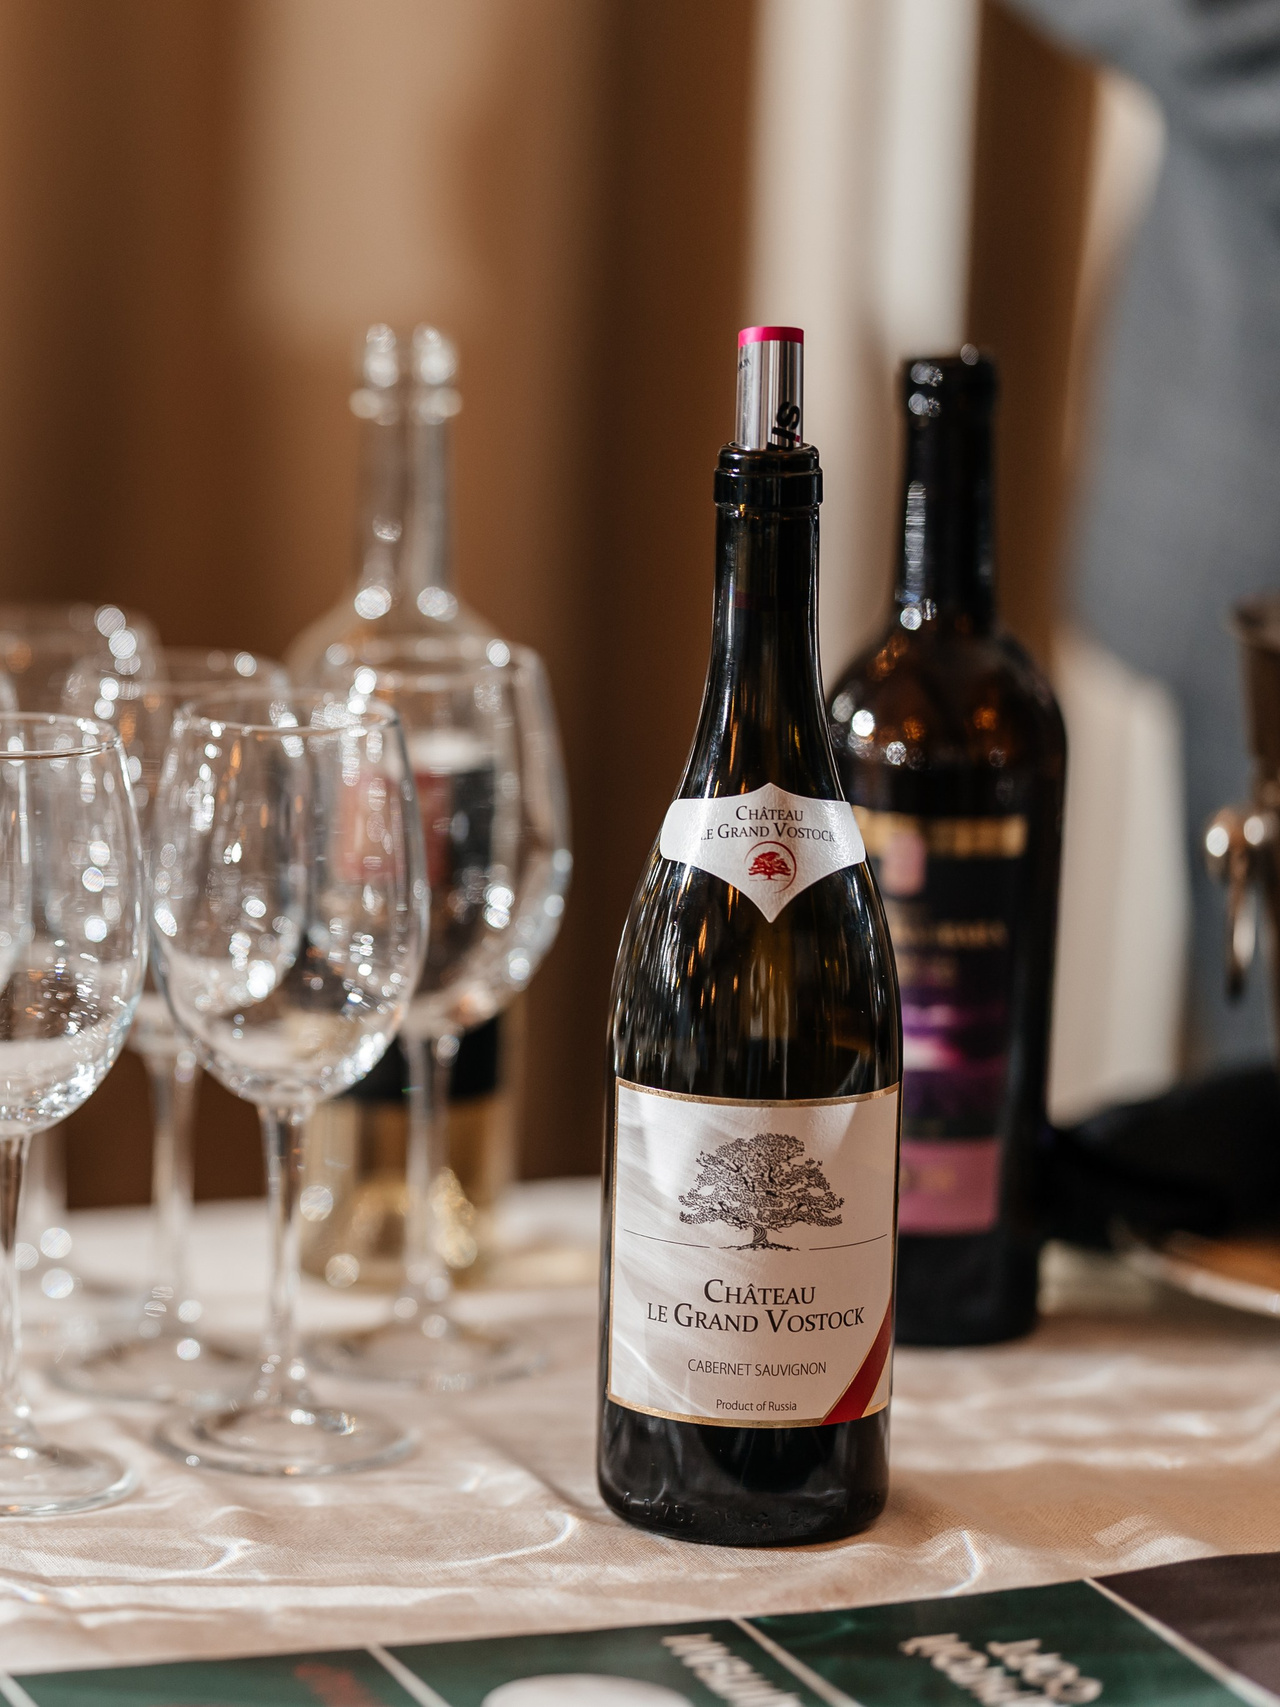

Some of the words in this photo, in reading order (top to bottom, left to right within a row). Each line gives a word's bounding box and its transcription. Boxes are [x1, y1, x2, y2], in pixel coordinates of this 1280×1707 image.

[736, 805, 804, 822] CHÂTEAU
[701, 828, 714, 840] E
[717, 823, 770, 839] GRAND
[773, 822, 836, 842] VOSTOCK
[704, 1278, 816, 1305] CHÂTEAU
[647, 1302, 668, 1323] LE
[674, 1303, 759, 1333] GRAND
[765, 1307, 865, 1334] VOSTOCK
[687, 1358, 752, 1376] CABERNET
[754, 1361, 827, 1377] SAUVIGNON
[716, 1398, 754, 1411] Product
[756, 1400, 767, 1411] of
[769, 1400, 797, 1412] Russia
